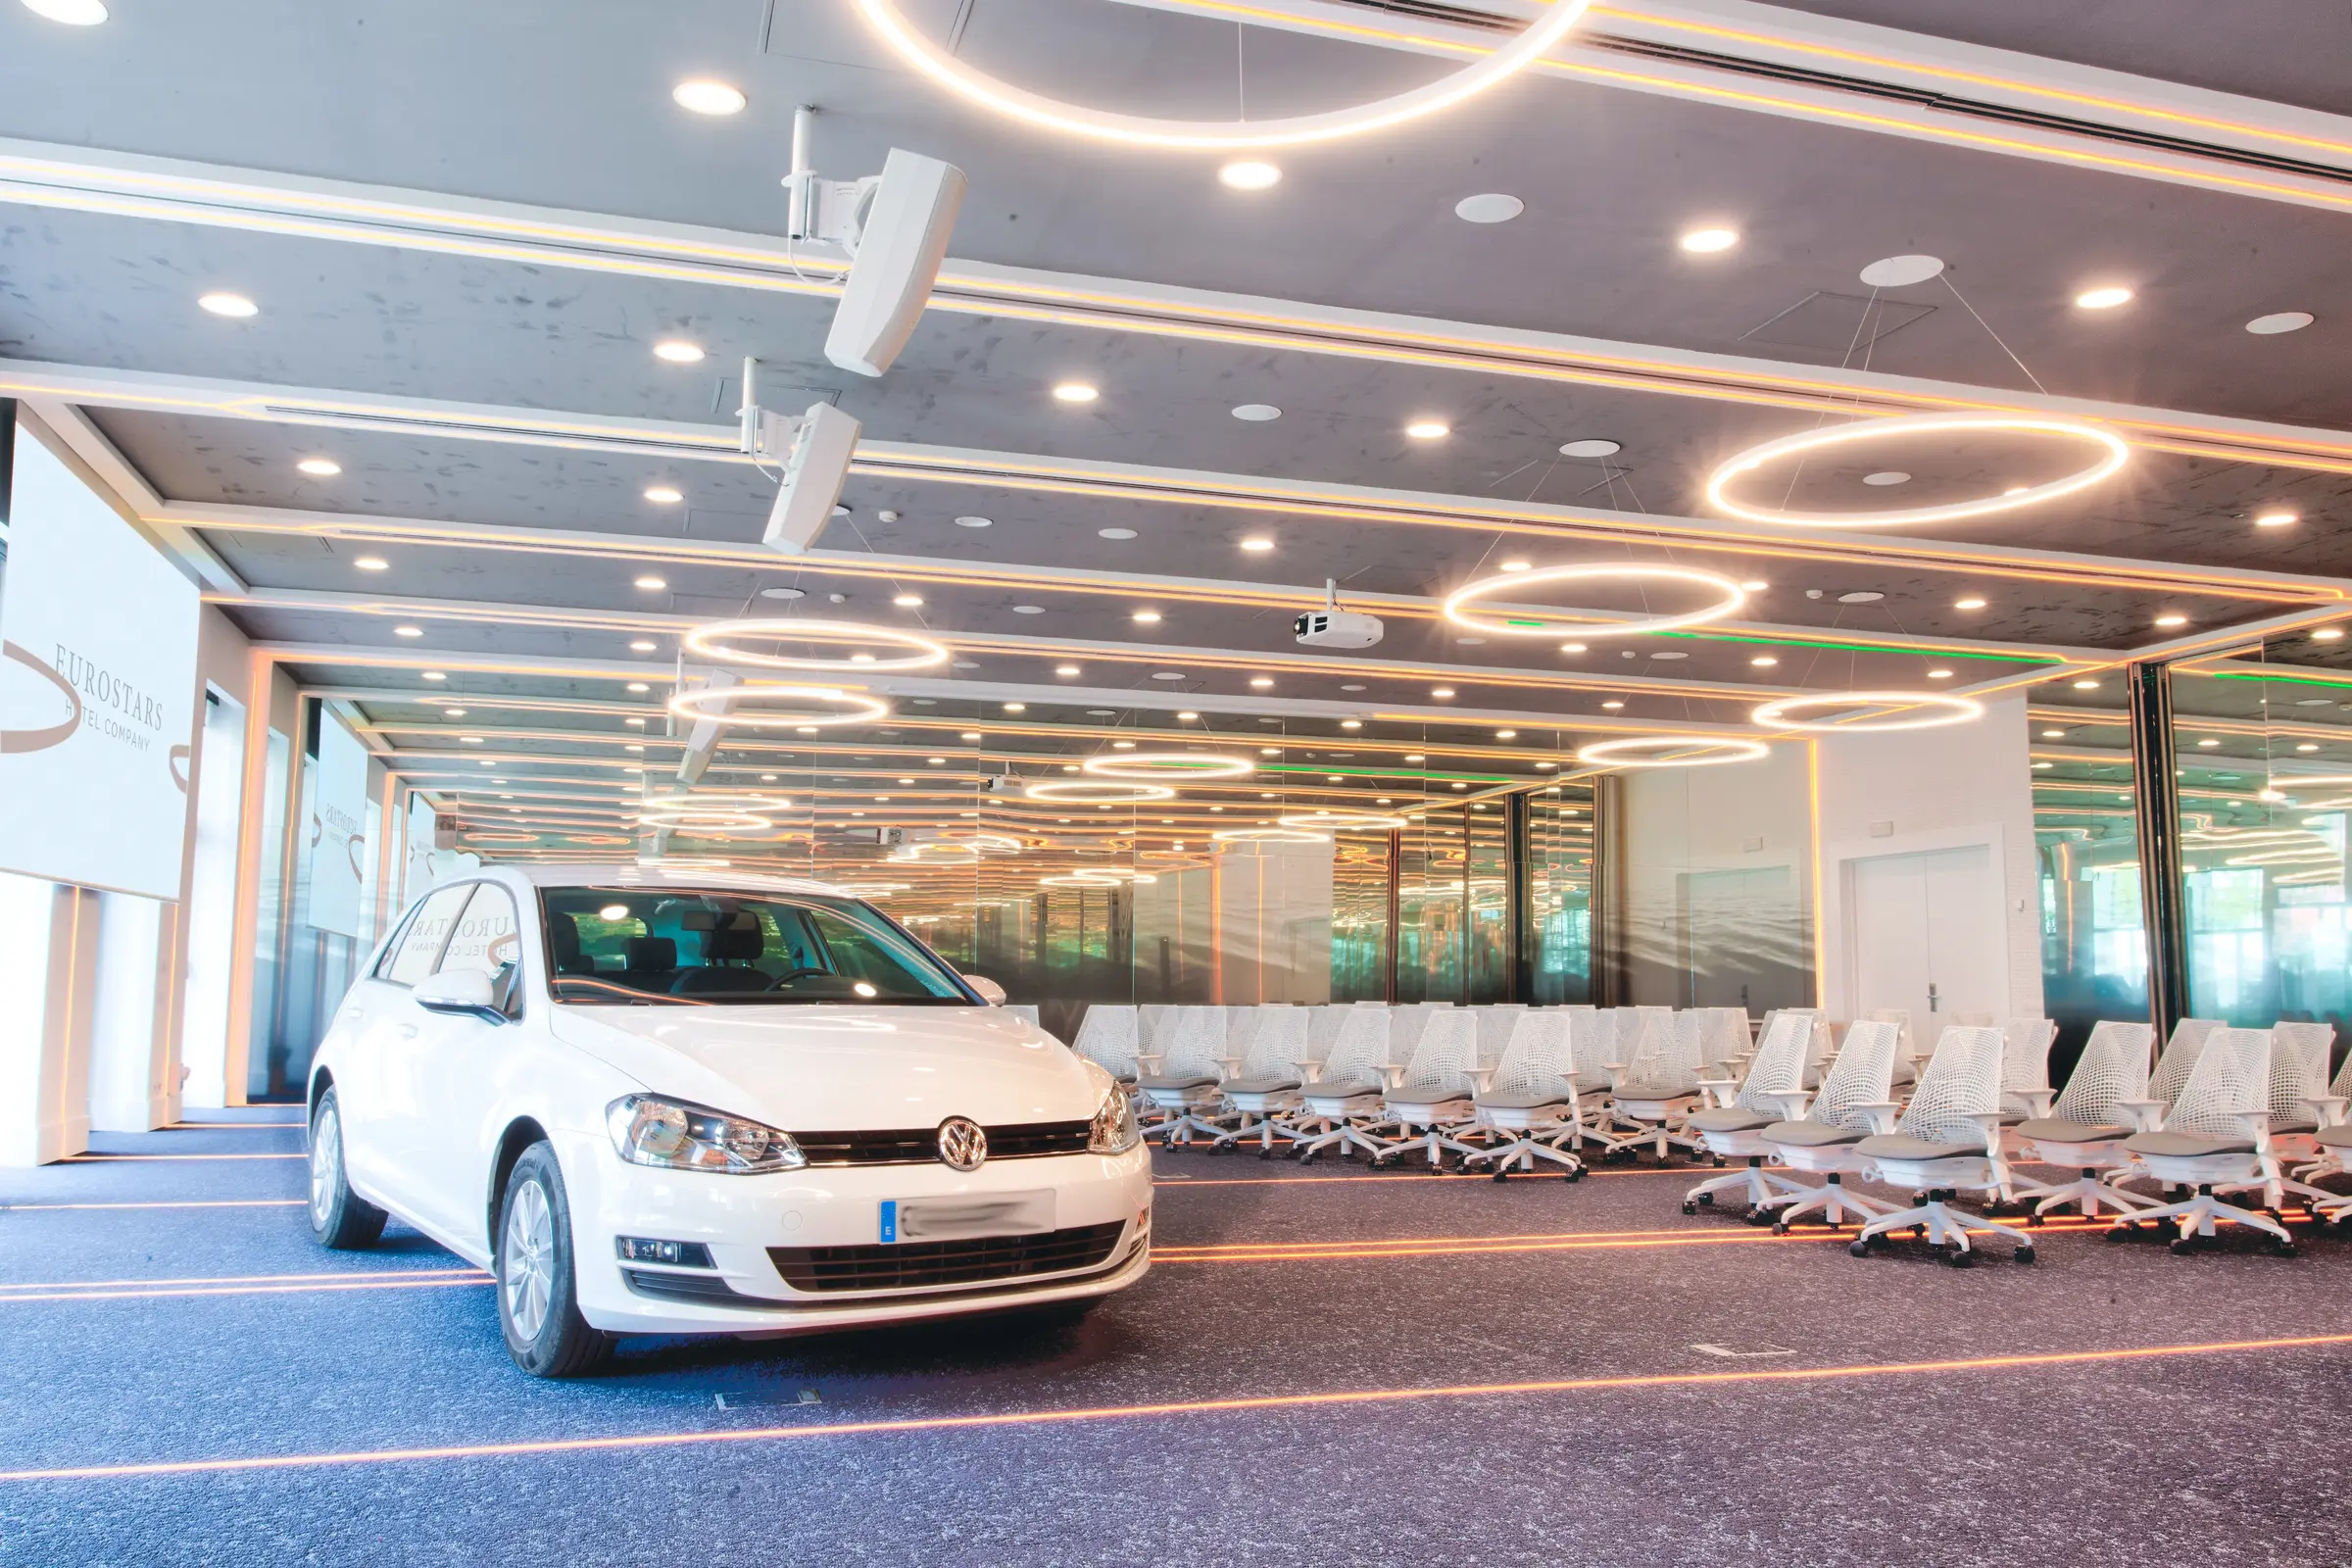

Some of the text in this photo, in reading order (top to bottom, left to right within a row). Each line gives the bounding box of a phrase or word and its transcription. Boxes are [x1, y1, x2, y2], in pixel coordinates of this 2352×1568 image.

[56, 643, 163, 731] EUROSTARS
[65, 698, 150, 752] HTEL COMPANY
